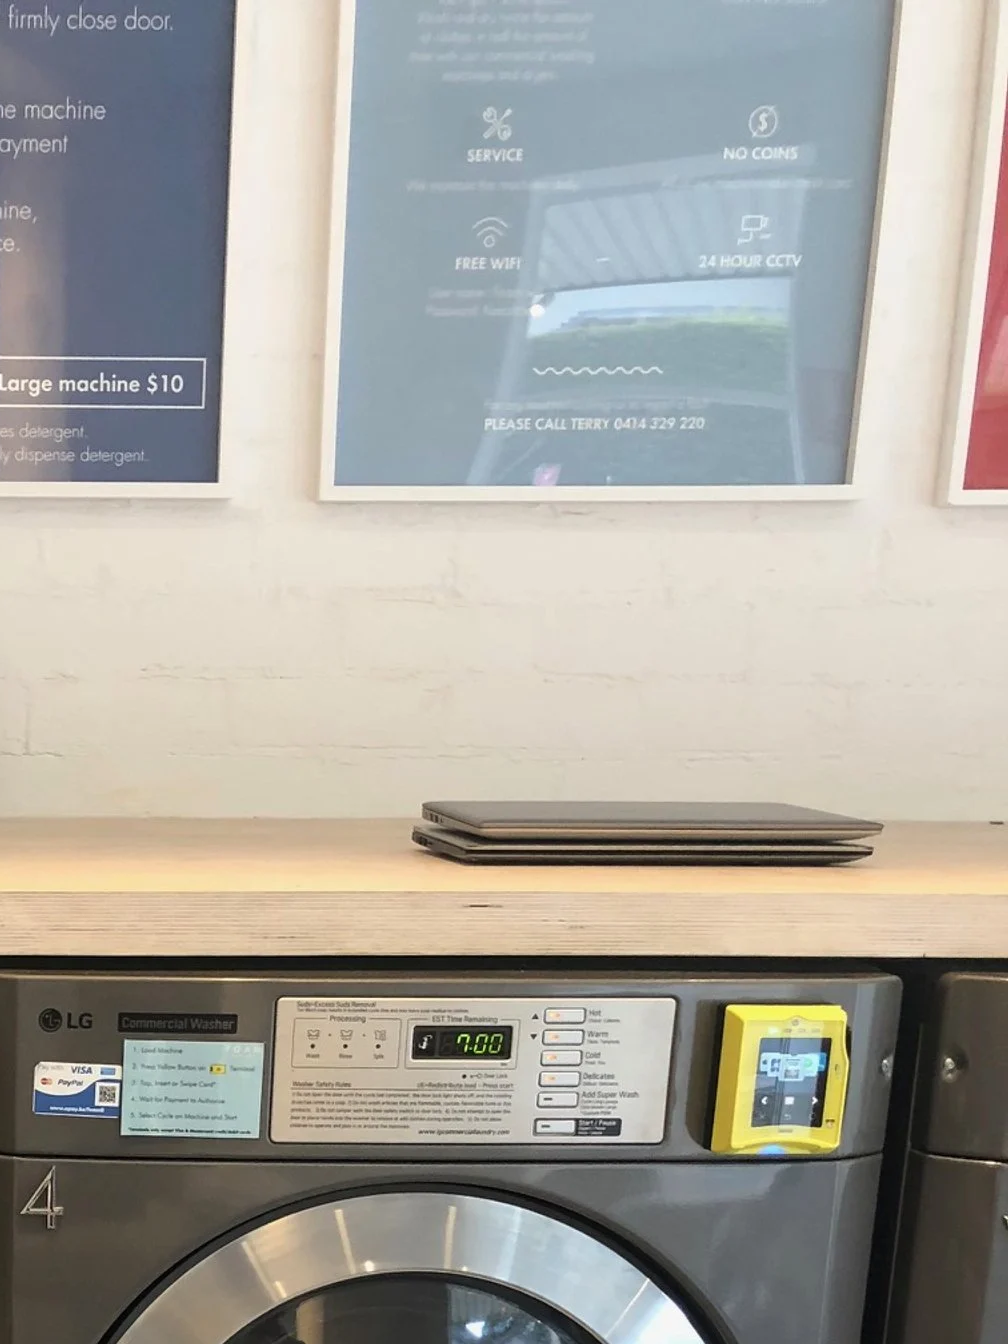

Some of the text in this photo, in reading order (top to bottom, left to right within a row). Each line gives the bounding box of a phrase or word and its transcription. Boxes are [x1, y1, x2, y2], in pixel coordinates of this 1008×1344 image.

[8, 4, 59, 36] firmly
[66, 5, 117, 31] close
[123, 5, 173, 31] door.
[24, 96, 106, 121] machine
[467, 148, 524, 163] SERVICE
[723, 146, 798, 160] NO COINS
[455, 256, 521, 270] FREE WIFI
[699, 254, 803, 268] 24 HOUR CCTV
[59, 375, 140, 394] machine
[146, 375, 184, 396] $10
[484, 417, 705, 431] PLEASE CALL TERRY 0414 329 220
[19, 423, 88, 442] detergent.
[14, 447, 75, 465] dispense
[66, 1013, 235, 1031] LG Commercial Washer
[329, 1015, 366, 1023] Processing
[71, 1066, 92, 1074] VISA
[58, 1079, 83, 1087] PayPal
[20, 1165, 64, 1230] 4
